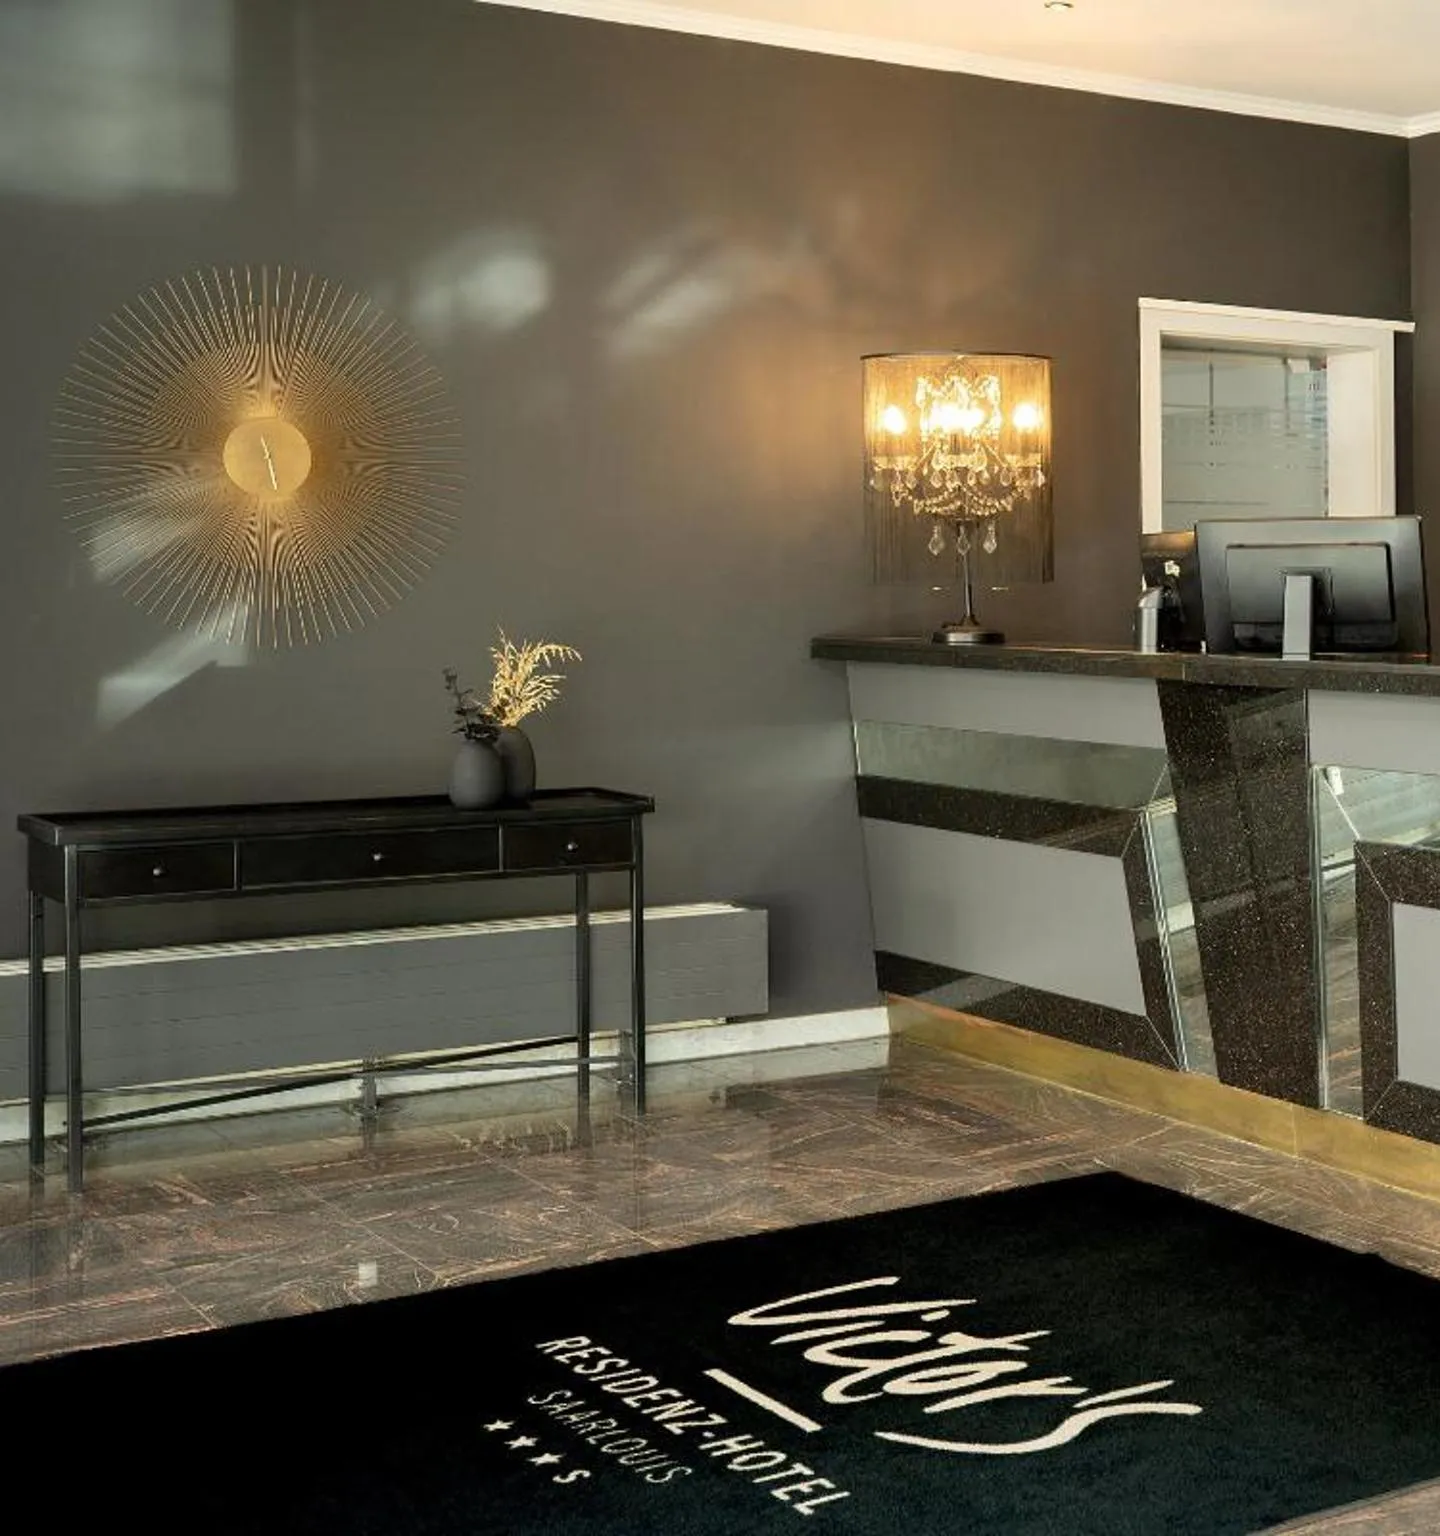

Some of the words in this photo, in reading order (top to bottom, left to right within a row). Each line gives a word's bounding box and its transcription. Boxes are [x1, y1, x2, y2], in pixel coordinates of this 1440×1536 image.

[526, 1390, 694, 1486] SAARLOUIS
[535, 1335, 852, 1517] RESIDENZ-HOTEL
[727, 1276, 1204, 1456] Victor's
